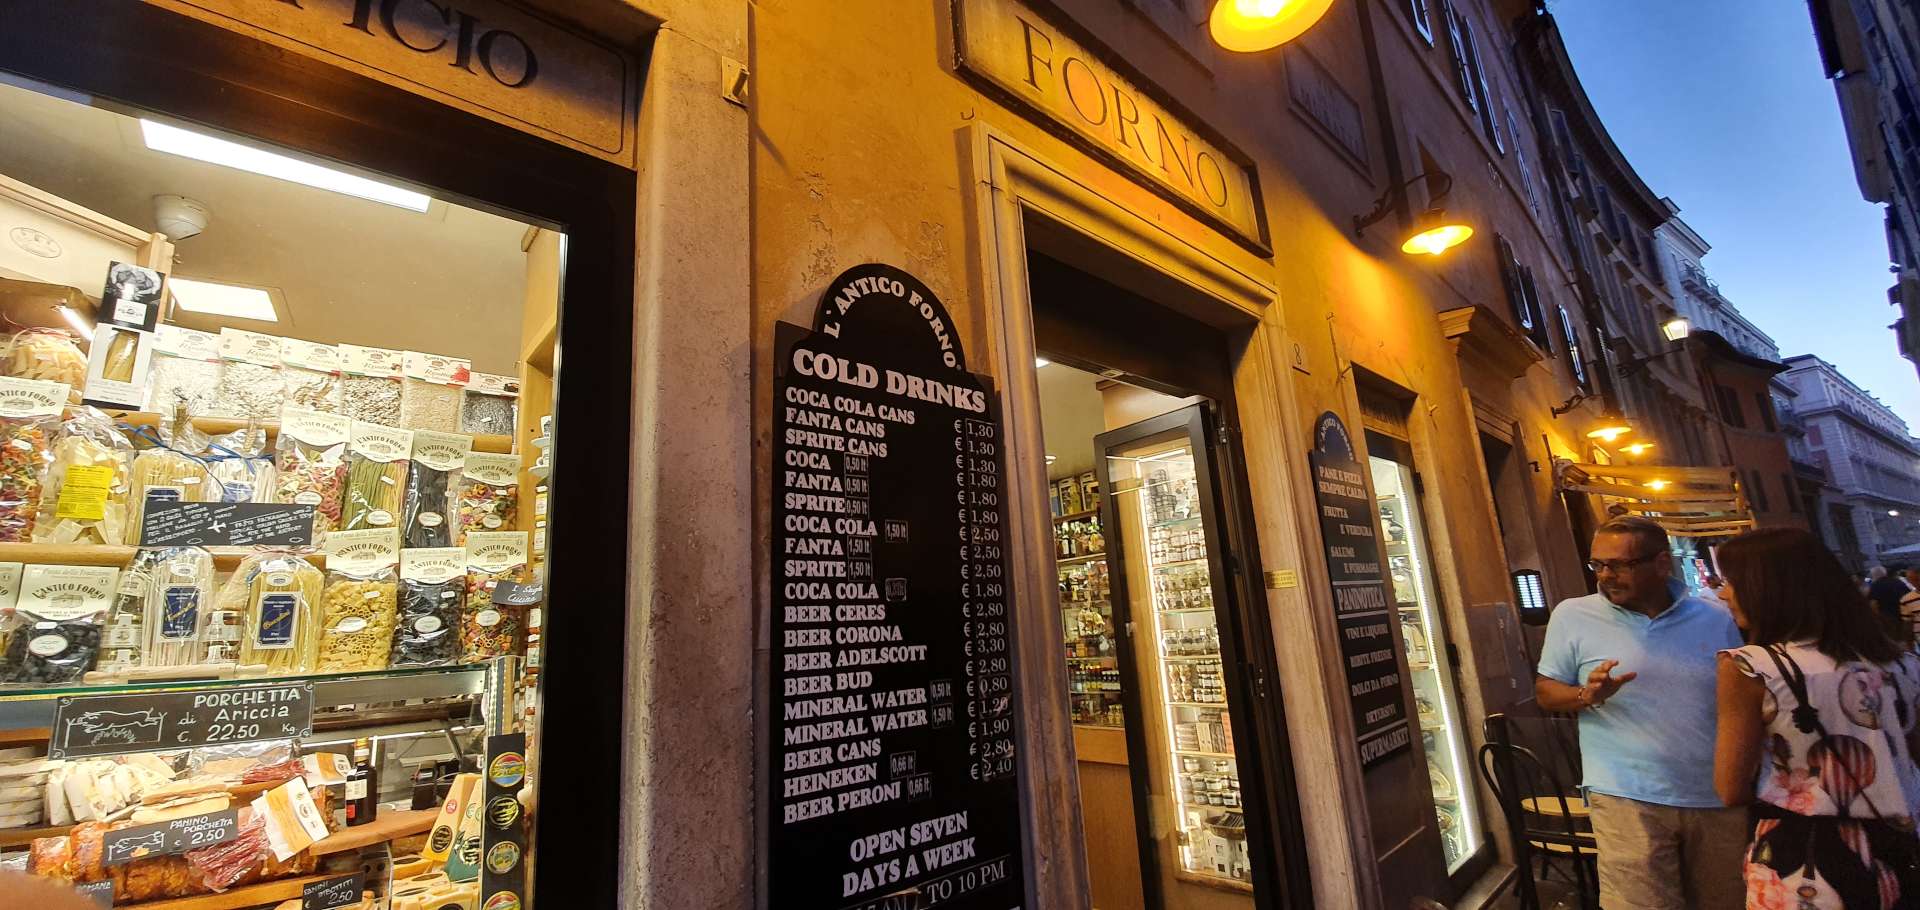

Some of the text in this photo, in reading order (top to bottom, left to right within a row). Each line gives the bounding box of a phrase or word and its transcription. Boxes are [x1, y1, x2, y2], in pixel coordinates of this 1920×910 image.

[275, 0, 538, 88] ICIO
[1016, 15, 1227, 207] FORNO
[909, 290, 957, 368] FORNO
[793, 349, 985, 412] COLD DRINKS
[786, 387, 994, 438] COCA COLA CANS € 1,30
[786, 407, 994, 455] FANTA CANS € 1,30
[785, 450, 831, 470] COCA
[957, 472, 964, 486] €
[970, 472, 996, 487] 1,80
[786, 428, 995, 473] SPRITE CANS € 1,30
[785, 471, 843, 492] FANTA
[957, 490, 965, 504] €
[971, 491, 997, 506] 1,80
[785, 492, 845, 513] SPRITE
[959, 509, 966, 523] €
[972, 510, 998, 525] 1,80
[785, 515, 831, 533] COCA
[835, 519, 878, 536] COLA
[960, 526, 967, 540] €
[973, 527, 999, 542] 2,50
[785, 538, 844, 555] FANTA
[960, 545, 968, 560] €
[974, 546, 1000, 561] 2,50
[785, 560, 846, 577] SPRITE
[961, 564, 969, 579] €
[975, 564, 1001, 578] 2,50
[77, 583, 105, 600] FORNO
[785, 583, 831, 599] COCA
[836, 583, 879, 599] COLA
[962, 583, 970, 598] €
[976, 583, 1002, 598] 1,80
[1336, 586, 1386, 610] PANINOTECA
[784, 602, 1003, 622] BEER CERES € 2,80
[784, 622, 1004, 647] BEER CORONA € 2,80
[784, 638, 1005, 671] BEER ADELSCOTT € 3,30
[784, 658, 1006, 696] BEER BUD € 2,80
[194, 688, 301, 708] PORCHETTA
[215, 704, 289, 722] Ariccia
[784, 695, 868, 720] MINERAL
[871, 688, 927, 709] WATER
[967, 681, 974, 696] €
[980, 677, 1007, 694] 0,80
[206, 724, 259, 741] 22.50
[784, 718, 868, 745] MINERAL
[871, 709, 928, 732] WATER
[968, 701, 975, 717] €
[784, 719, 1009, 771] BEER CANS € 1,90
[784, 763, 877, 797] HEINEKEN
[970, 743, 976, 756] €
[983, 739, 1010, 757] 2,80
[784, 796, 834, 824] BEER
[838, 781, 900, 812] PERONI
[971, 763, 979, 780] €
[169, 816, 208, 829] PANINO
[184, 818, 233, 833] PORCHETTA
[191, 828, 225, 845] 2.50
[850, 811, 967, 862] OPEN SEVEN
[843, 837, 975, 897] DAYS A WEEK
[927, 879, 952, 904] TO
[959, 871, 975, 893] 10
[981, 860, 1005, 886] PM
